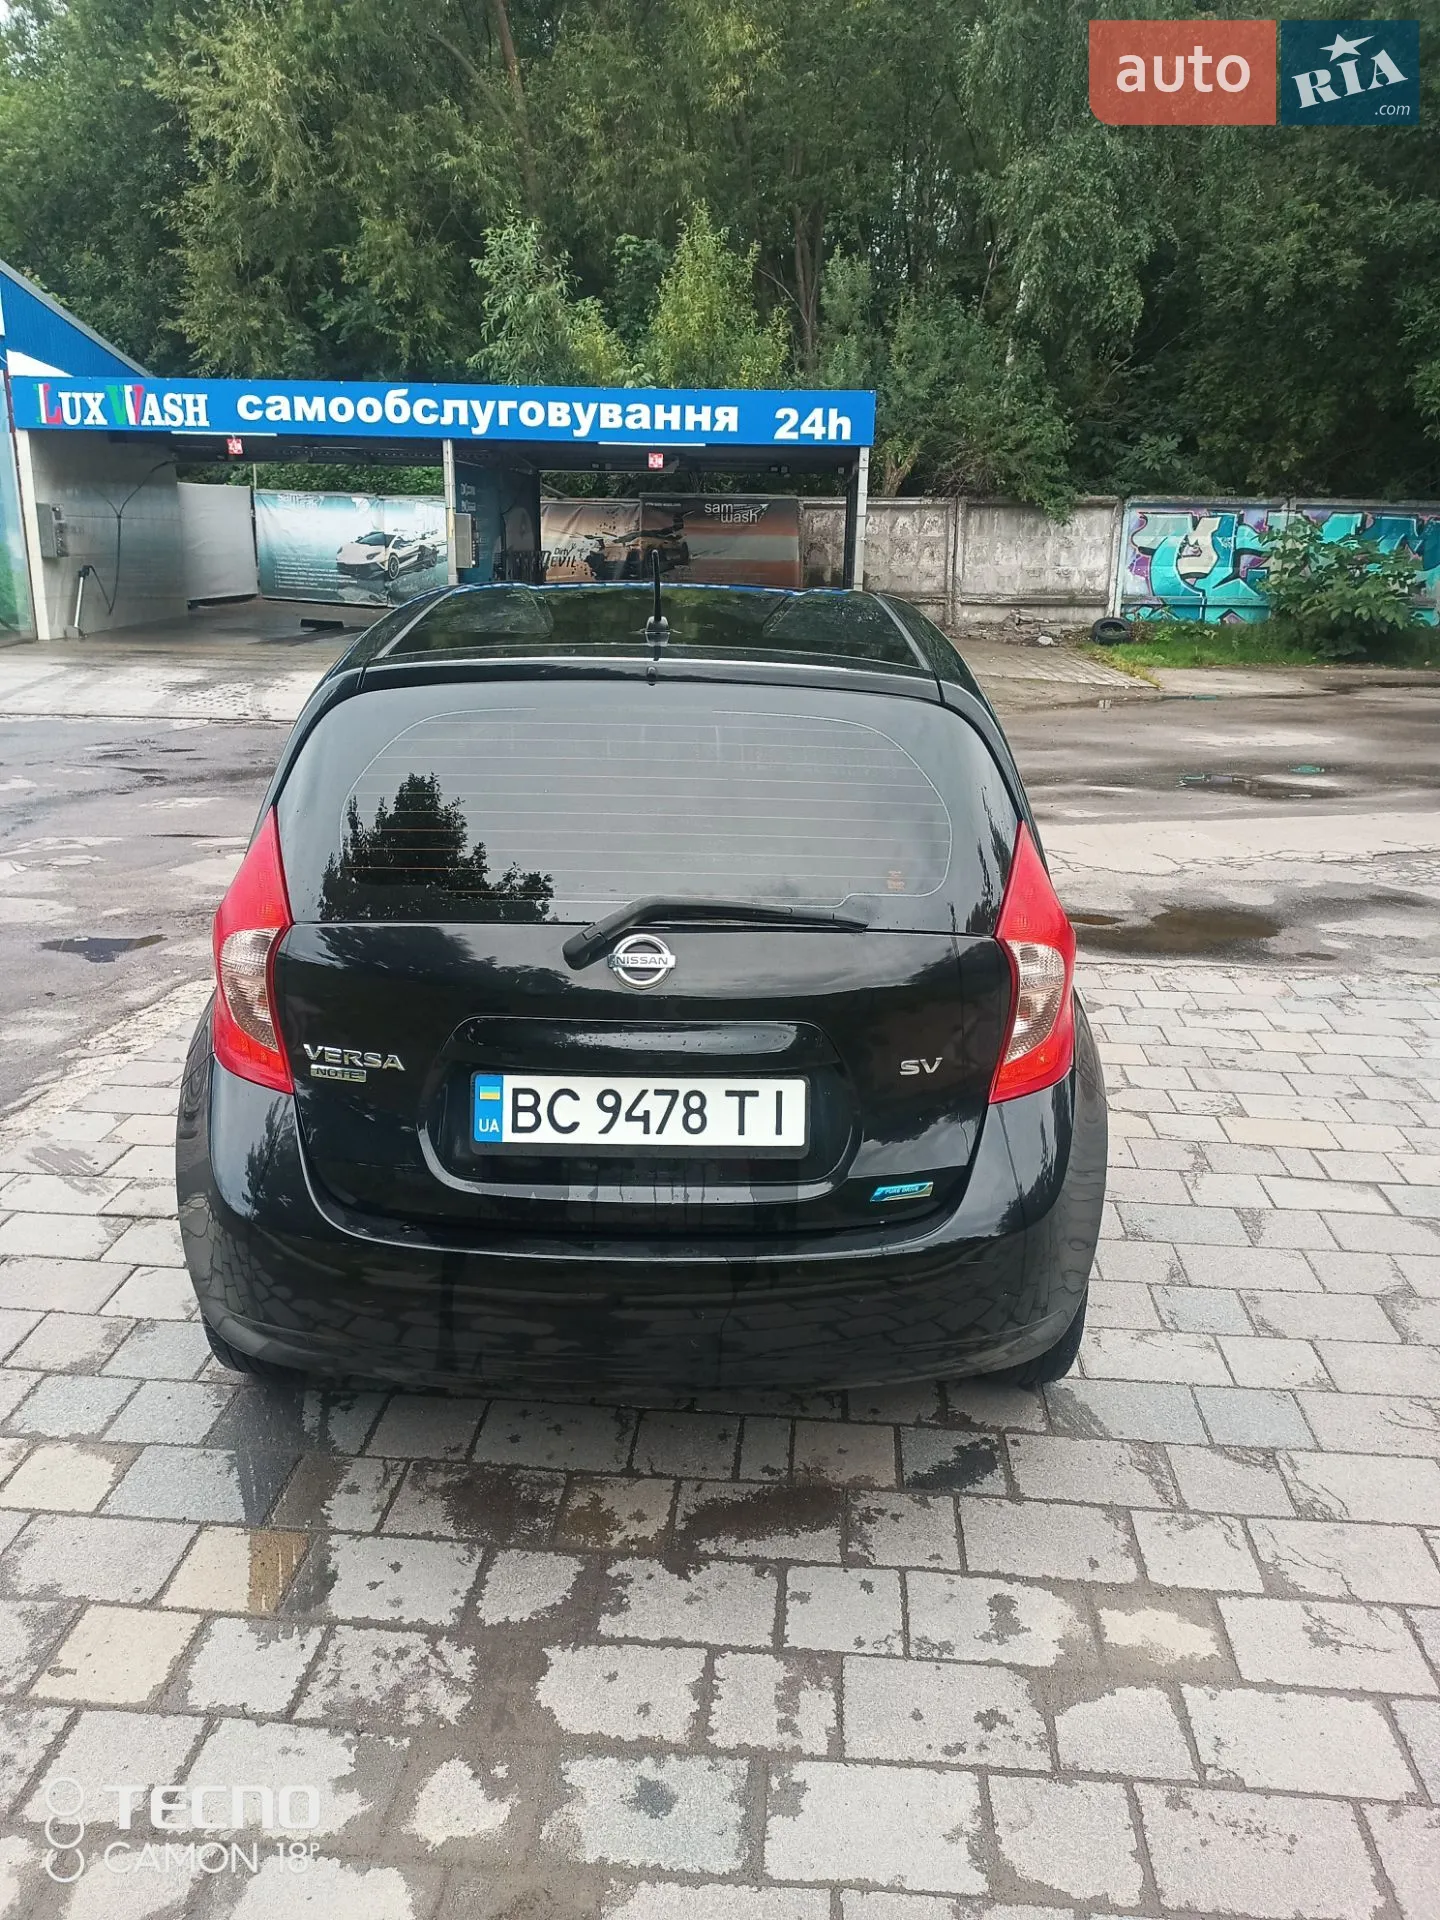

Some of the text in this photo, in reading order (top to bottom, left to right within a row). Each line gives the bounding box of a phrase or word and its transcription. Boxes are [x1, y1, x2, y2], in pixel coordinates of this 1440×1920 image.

[236, 388, 852, 440] самообслуговування 24h
[704, 503, 733, 514] sam
[721, 511, 758, 523] wash
[615, 956, 668, 965] NISSAN
[303, 1043, 406, 1071] VERSA
[316, 1067, 361, 1080] NOTE
[899, 1056, 943, 1076] SV
[511, 1088, 581, 1134] BC
[597, 1089, 708, 1136] 9478
[478, 1117, 500, 1134] UA
